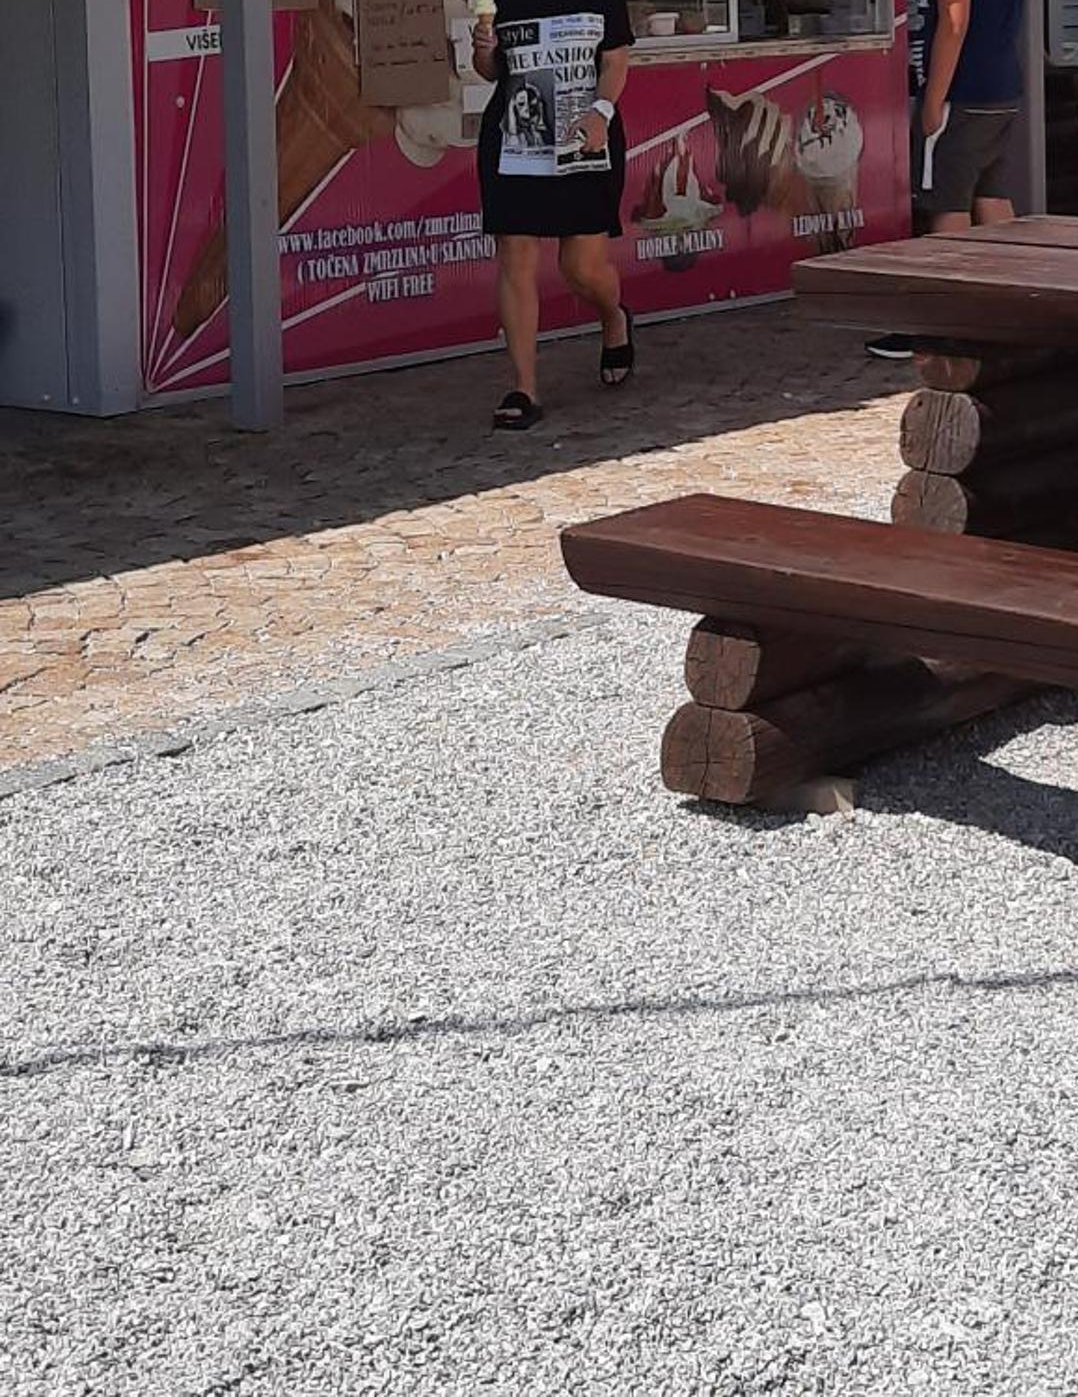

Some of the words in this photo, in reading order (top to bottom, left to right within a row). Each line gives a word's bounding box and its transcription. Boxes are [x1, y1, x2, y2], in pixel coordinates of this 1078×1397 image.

[186, 29, 223, 51] VIŠE
[532, 46, 594, 68] FASHIO
[277, 212, 484, 254] www.facebook.com/zmrzlina
[363, 247, 426, 275] ZMRZLINA
[366, 278, 400, 303] WIFI
[402, 273, 434, 298] FREE
